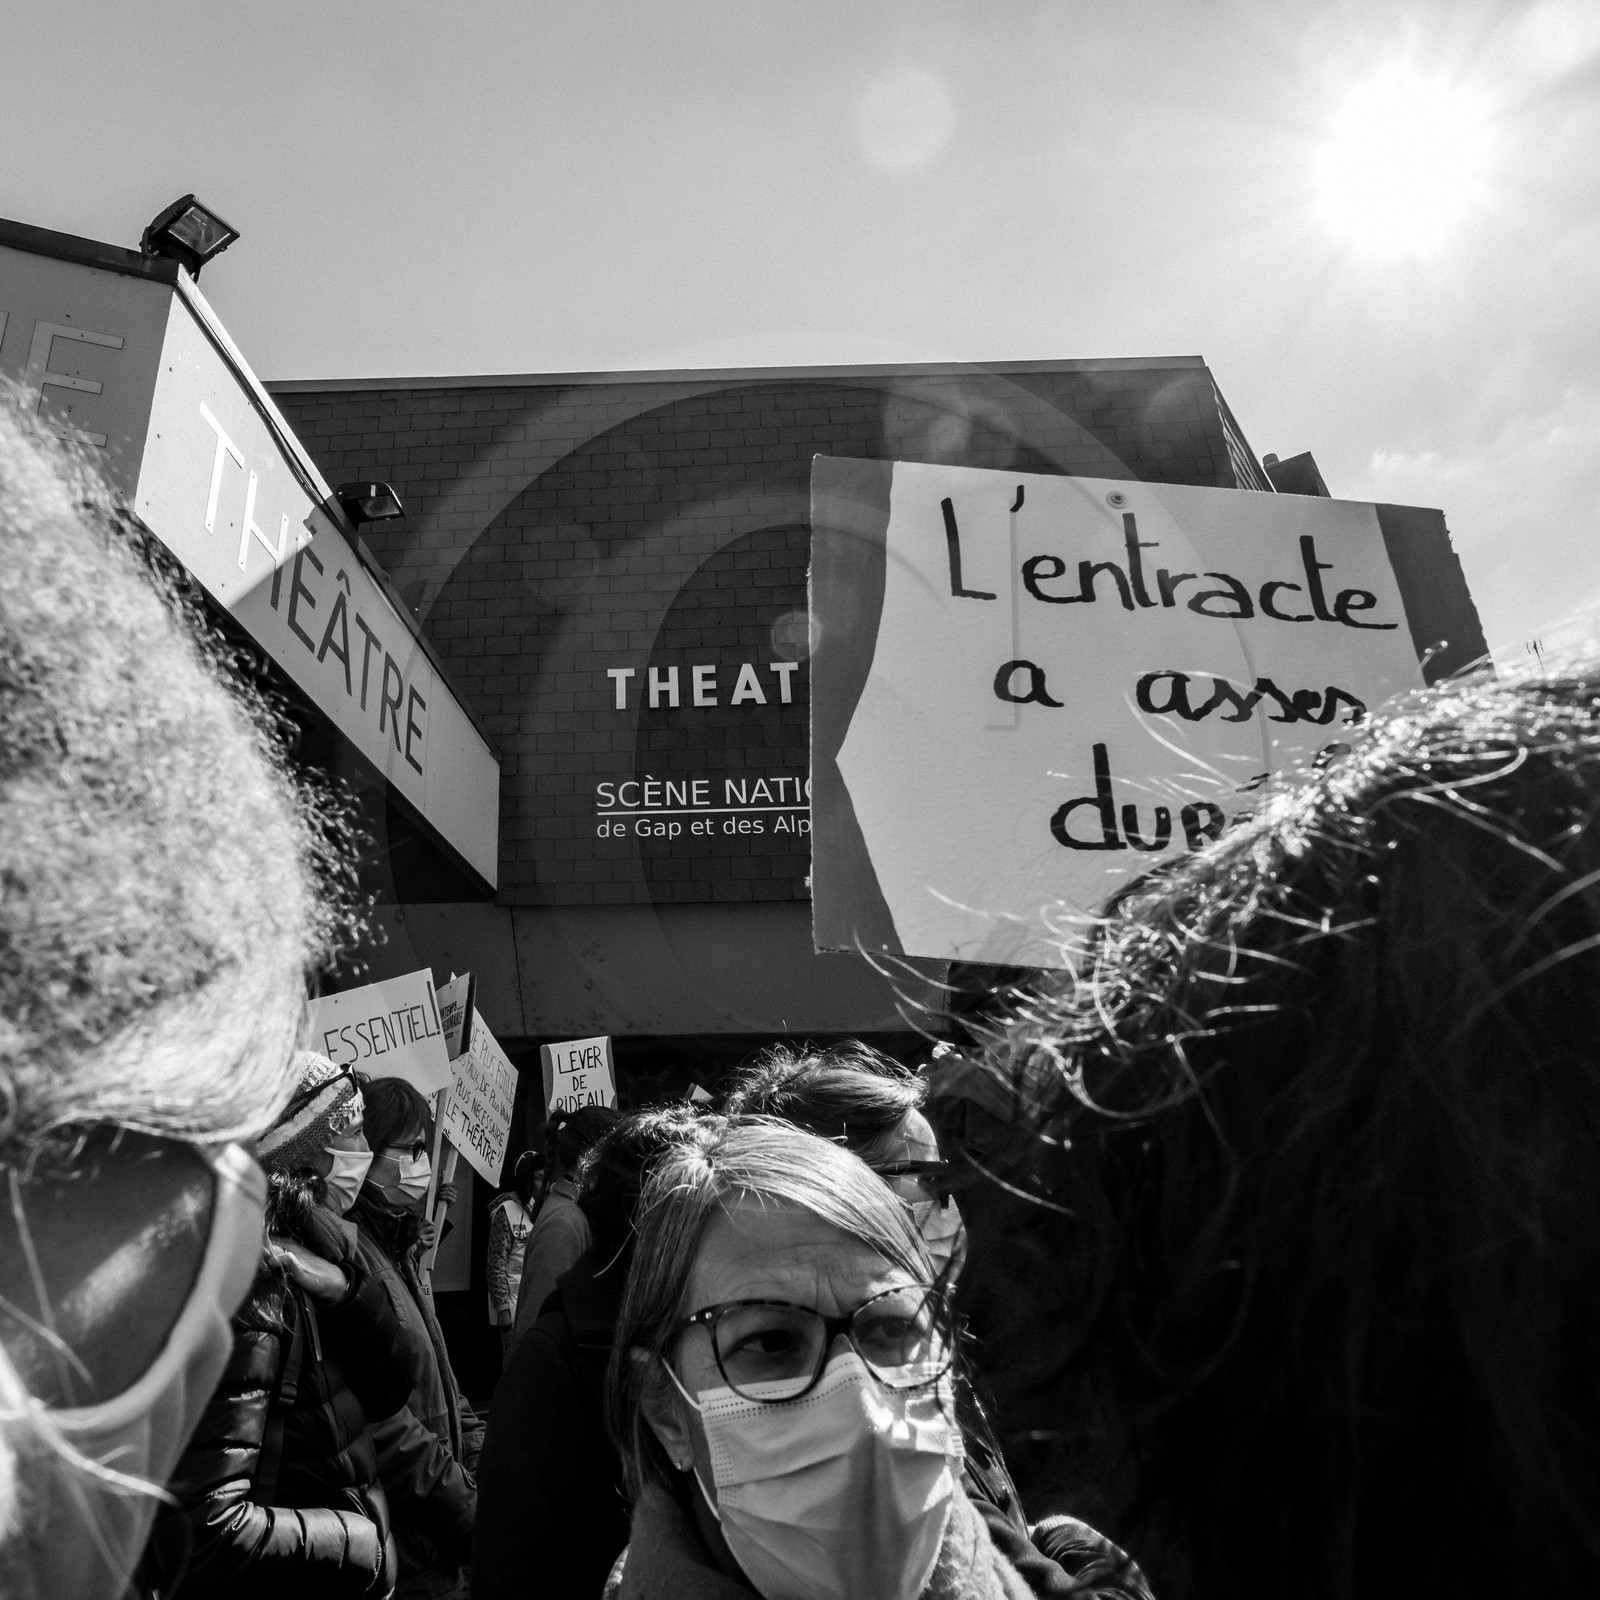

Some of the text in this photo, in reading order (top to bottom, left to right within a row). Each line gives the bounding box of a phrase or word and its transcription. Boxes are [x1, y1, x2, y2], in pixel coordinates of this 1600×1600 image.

[940, 484, 1400, 630] L'entracte
[993, 659, 1065, 708] a
[596, 774, 711, 808] SCÈNE
[597, 819, 626, 838] de
[634, 818, 682, 840] Gap
[690, 817, 714, 836] et
[722, 816, 765, 834] des
[479, 1038, 497, 1077] PLUS
[557, 1045, 604, 1075] LEVER
[572, 1074, 588, 1092] DE
[445, 1096, 460, 1124] LE
